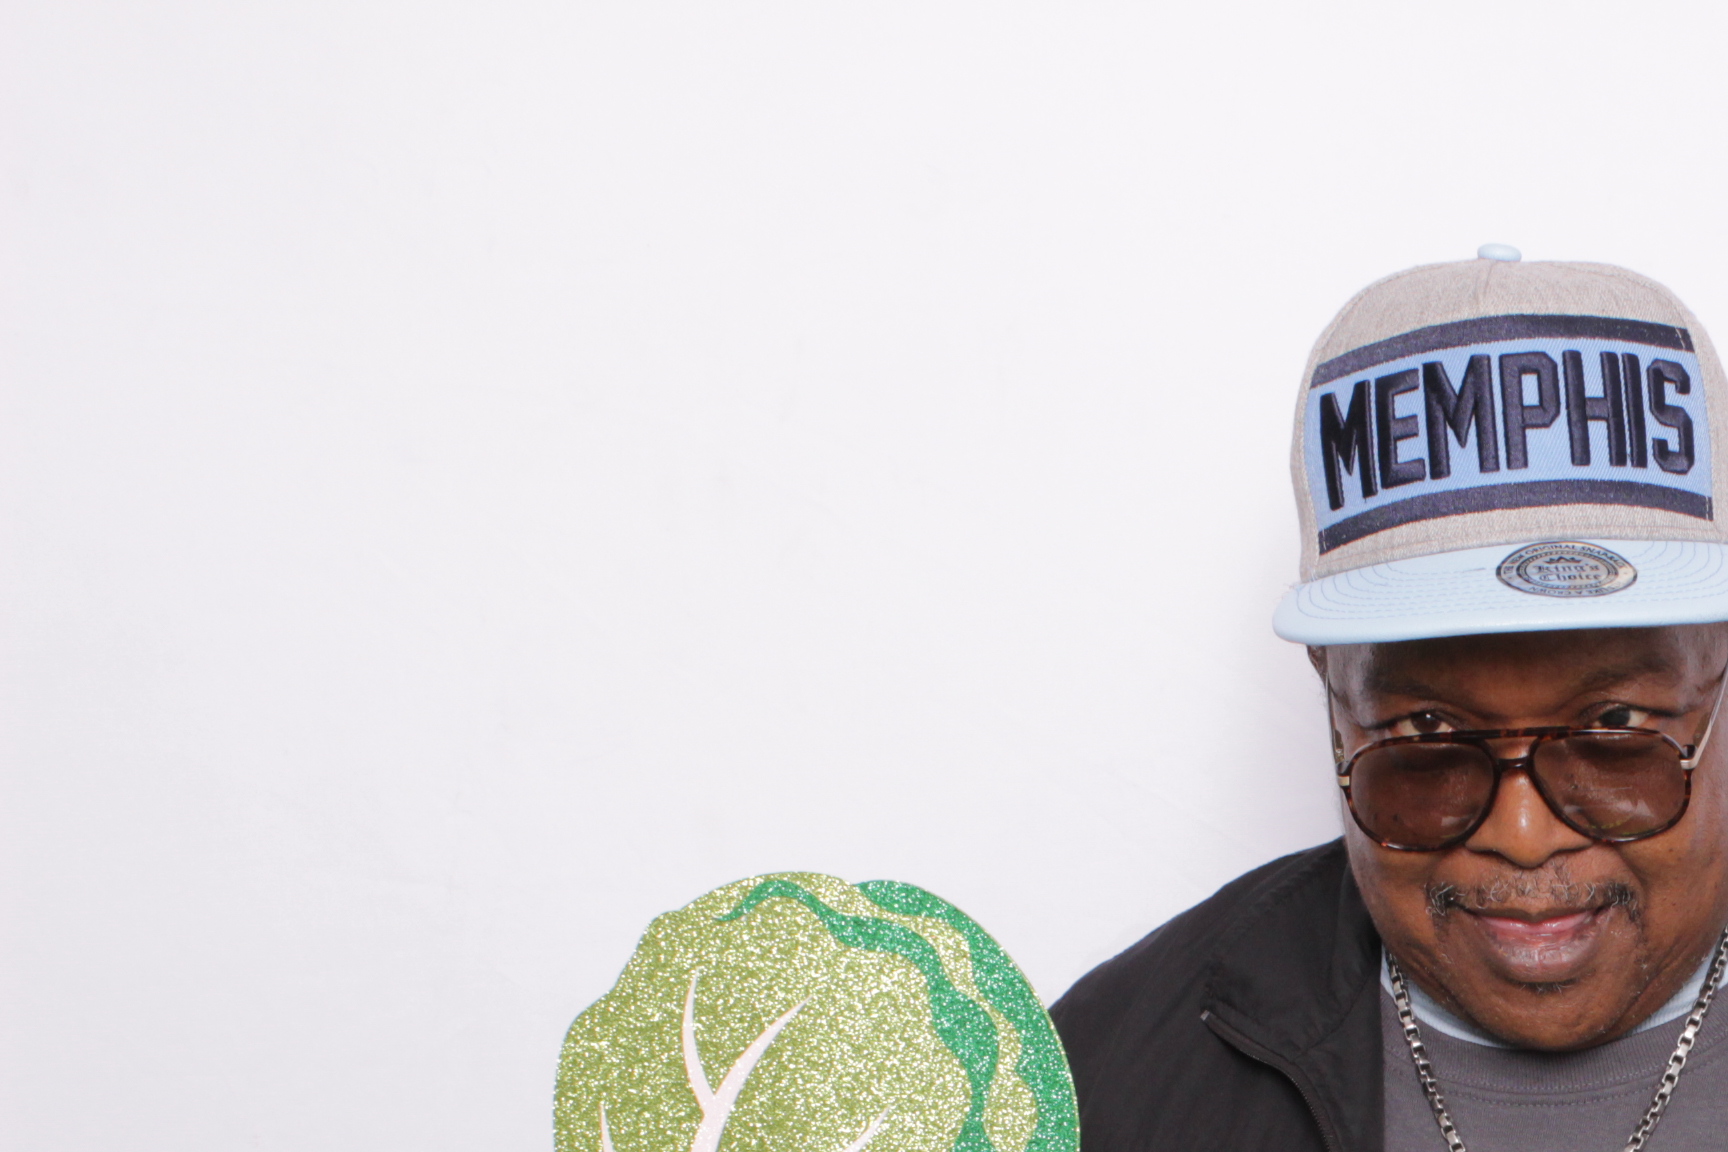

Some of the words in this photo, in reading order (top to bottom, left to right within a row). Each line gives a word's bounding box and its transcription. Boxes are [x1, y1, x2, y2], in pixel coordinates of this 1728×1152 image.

[1319, 349, 1695, 511] MEMPHIS
[1525, 544, 1577, 556] ORIGINAL
[1532, 562, 1601, 575] King's
[1539, 573, 1602, 582] Choice
[1529, 586, 1573, 596] CROWN
